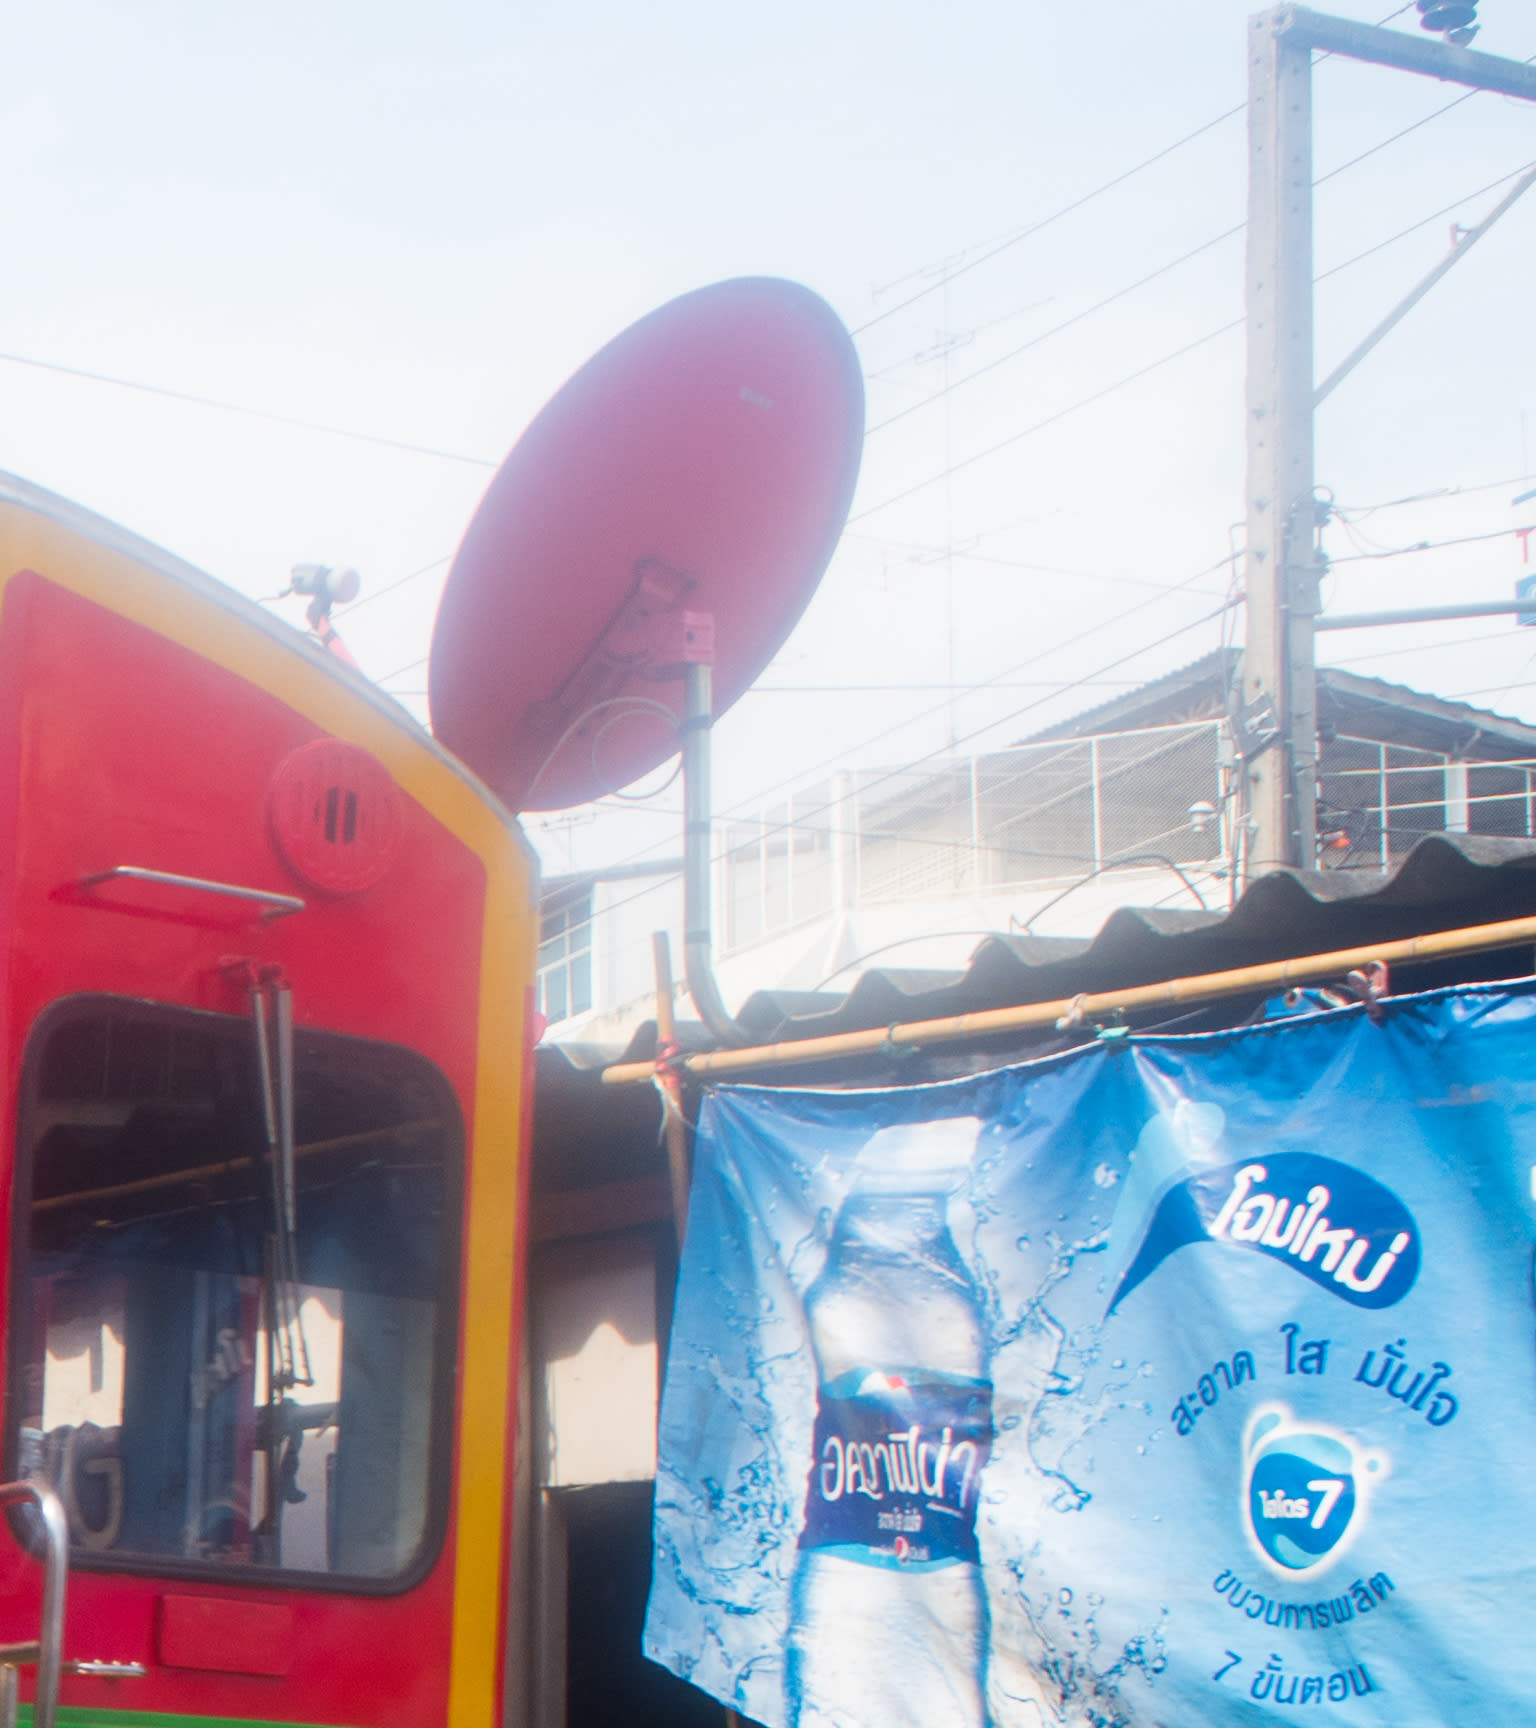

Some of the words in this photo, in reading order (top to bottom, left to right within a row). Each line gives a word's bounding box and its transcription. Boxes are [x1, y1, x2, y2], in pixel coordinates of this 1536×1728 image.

[1207, 1164, 1410, 1293] โฉมใหม่
[1171, 1350, 1256, 1436] สะอาด
[1280, 1322, 1330, 1375] ใส
[1353, 1338, 1459, 1427] มั่นใจ
[1307, 1480, 1346, 1530] 7
[1213, 1650, 1243, 1682] 7
[1250, 1653, 1378, 1705] ขั้นตอน
